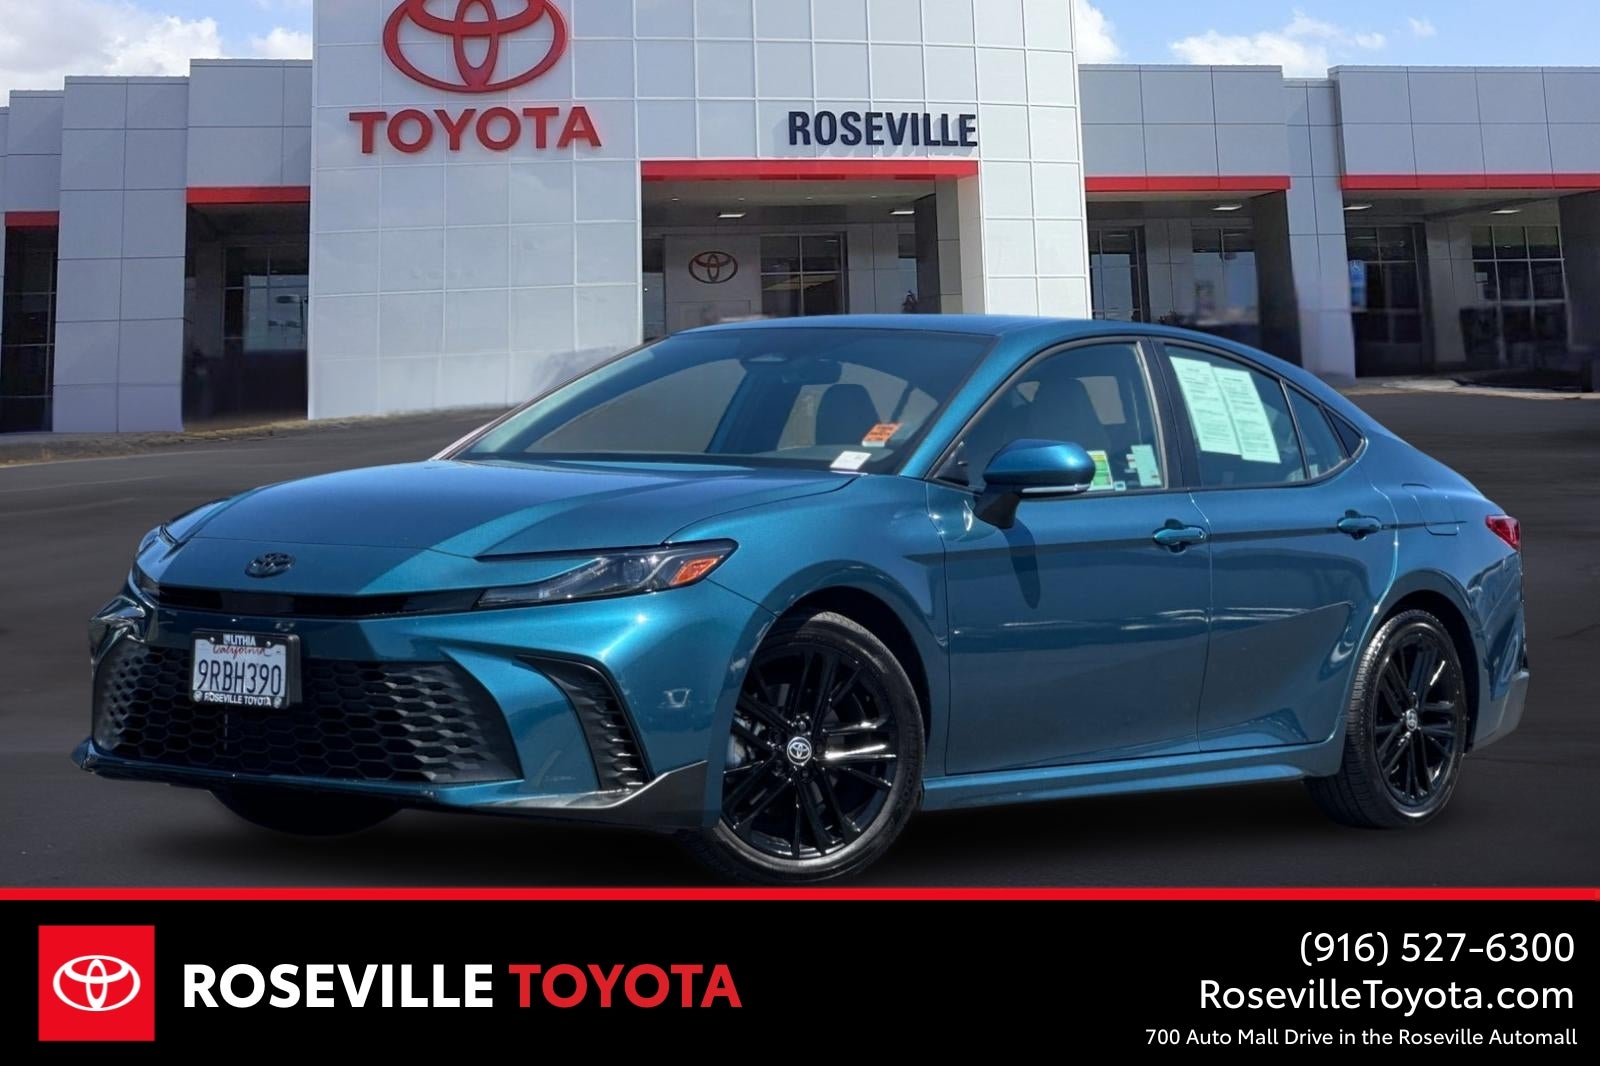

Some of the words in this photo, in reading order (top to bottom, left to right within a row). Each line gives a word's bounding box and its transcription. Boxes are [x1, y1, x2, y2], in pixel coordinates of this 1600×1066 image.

[349, 106, 602, 154] TOYOTA
[788, 110, 978, 147] ROSEVILLE
[213, 645, 271, 660] California
[229, 634, 256, 647] LITHIA
[197, 659, 282, 696] 9RBH390
[204, 691, 243, 705] ROSEVILLE
[244, 695, 272, 707] TOYOTA
